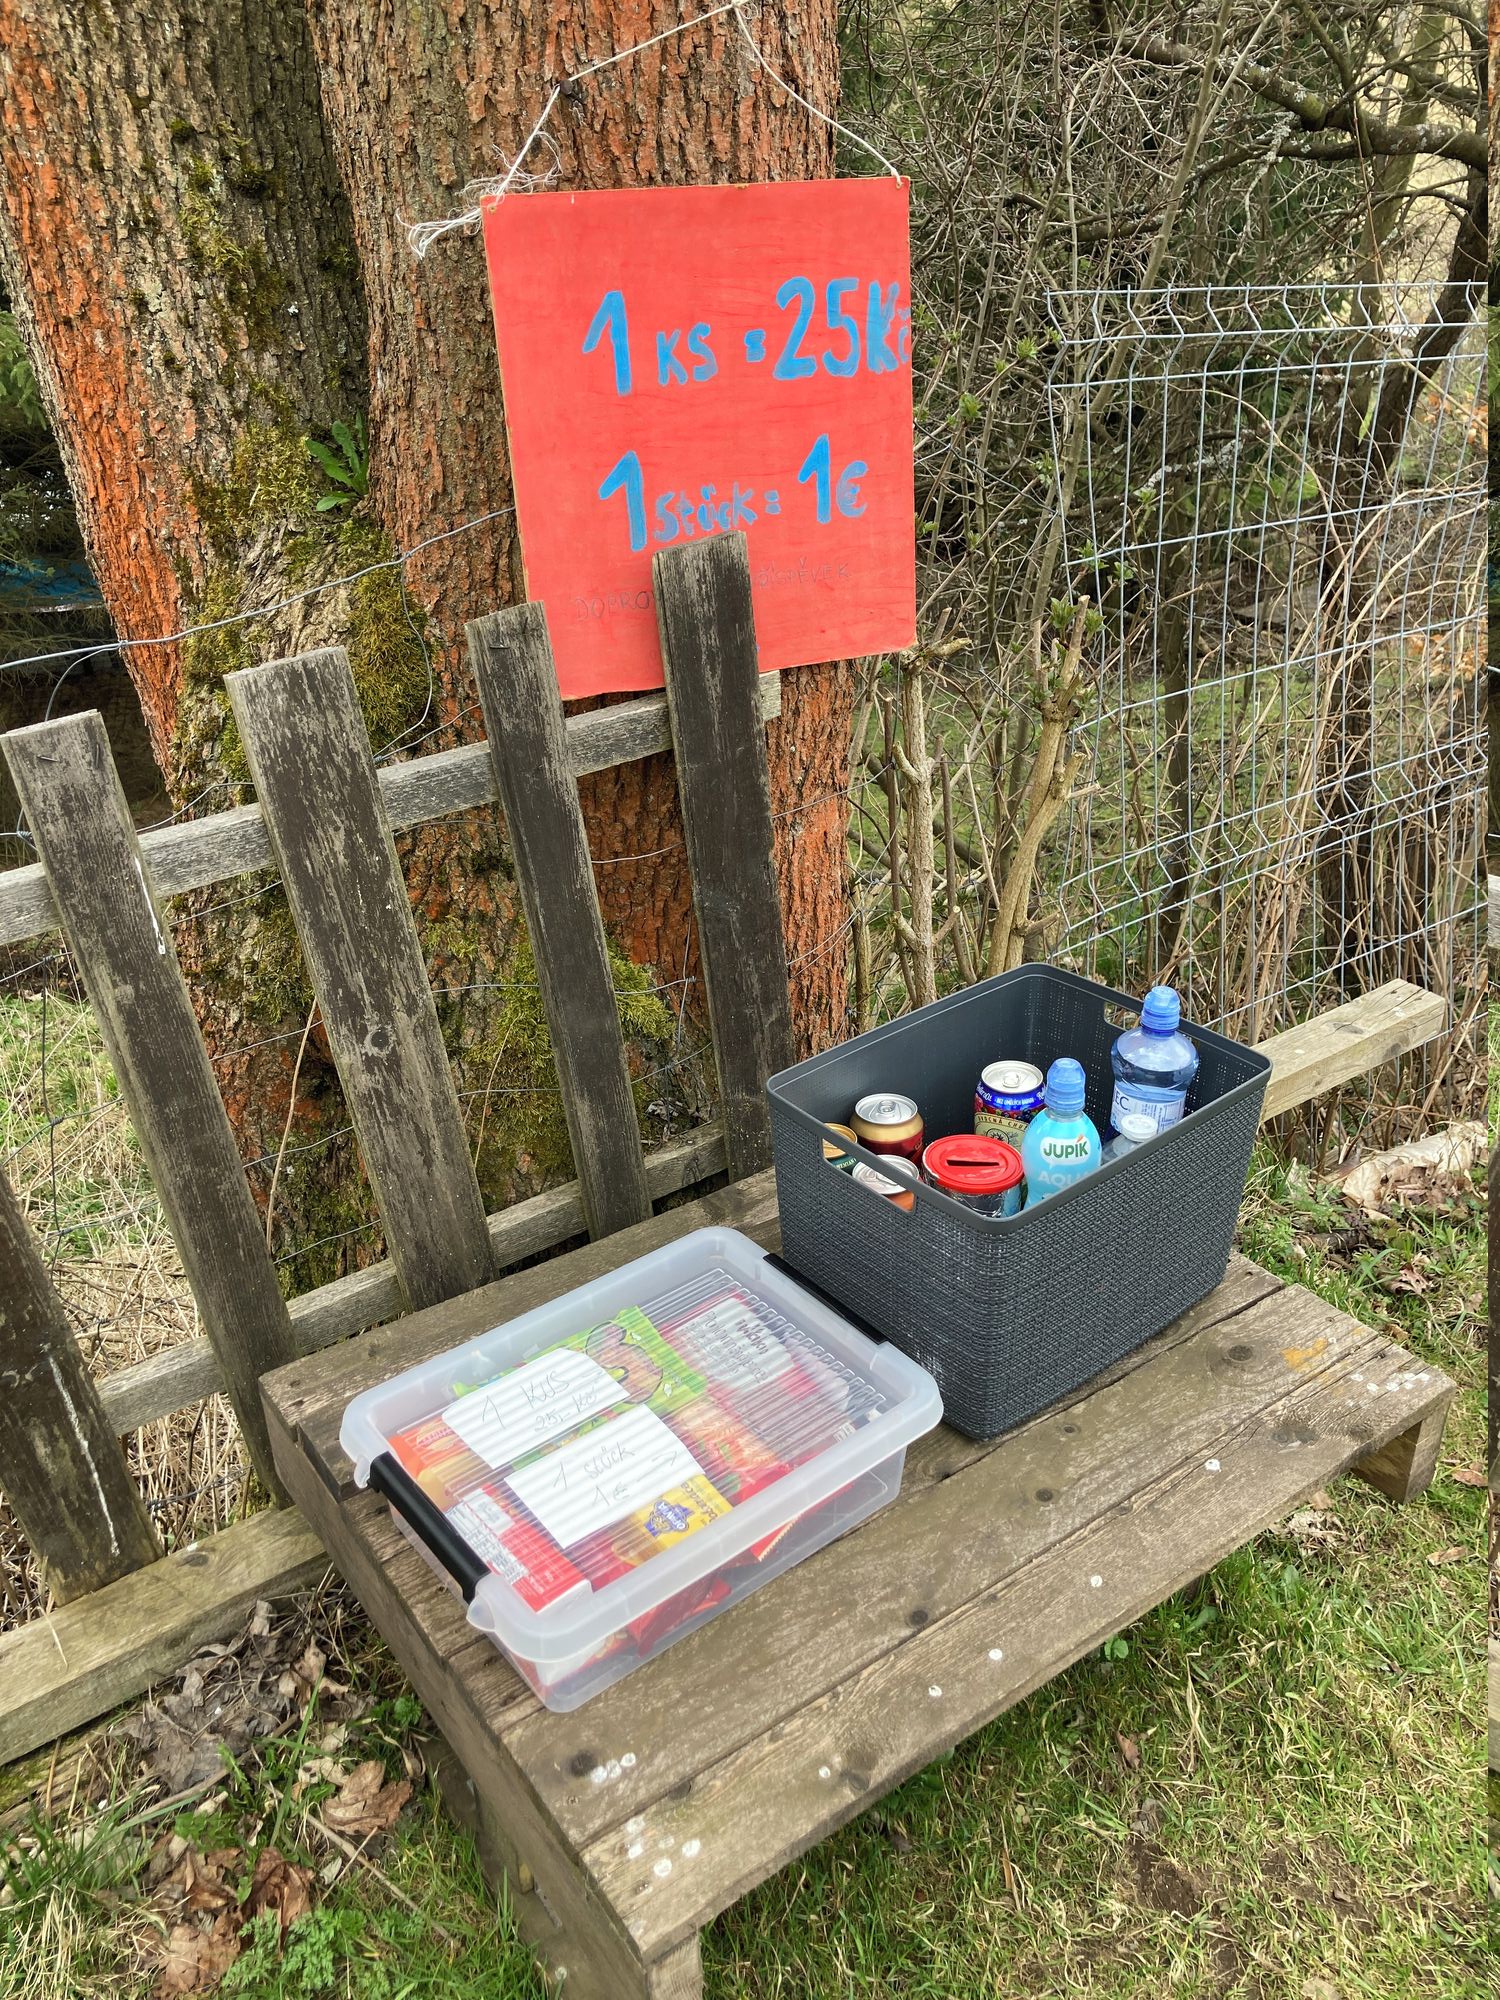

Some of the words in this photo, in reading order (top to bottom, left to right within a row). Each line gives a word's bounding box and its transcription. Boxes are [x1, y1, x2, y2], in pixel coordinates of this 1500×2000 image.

[583, 289, 632, 397] 1
[598, 450, 648, 552] 1
[575, 590, 652, 620] DOBRO
[1038, 1170, 1089, 1188] AQU
[520, 1370, 570, 1409] KUS
